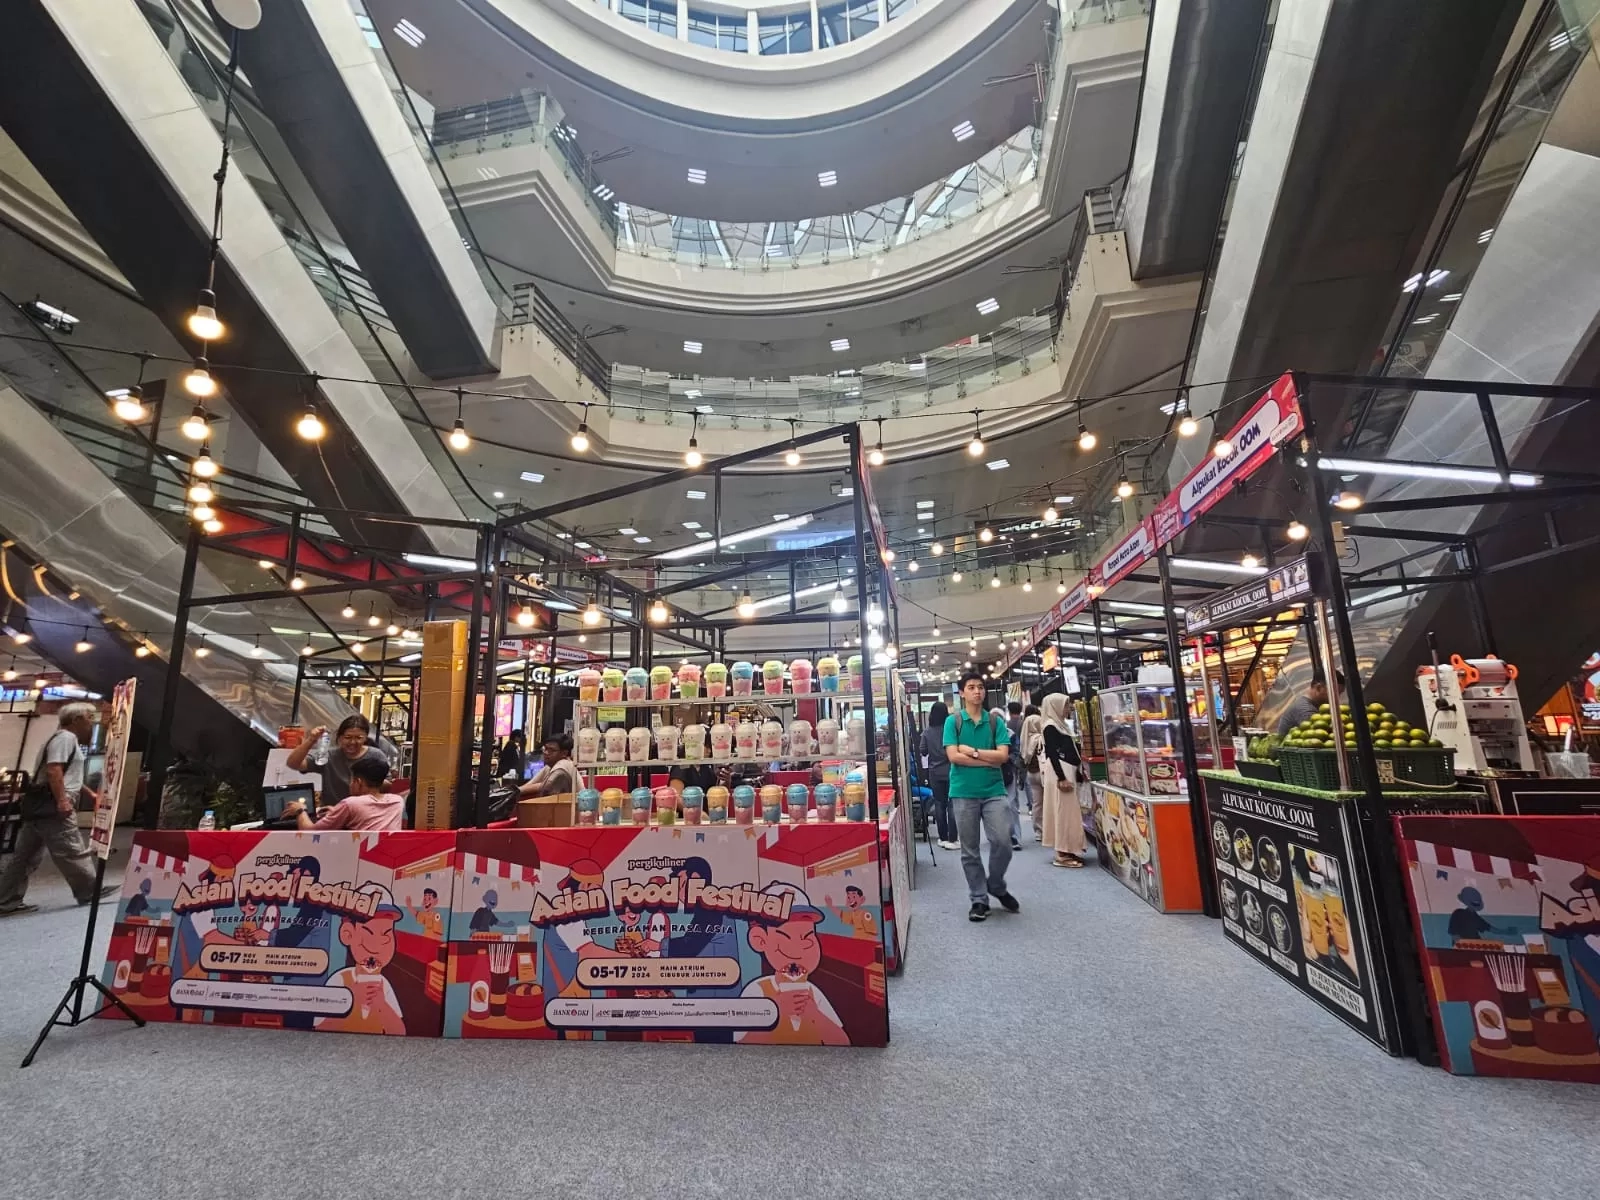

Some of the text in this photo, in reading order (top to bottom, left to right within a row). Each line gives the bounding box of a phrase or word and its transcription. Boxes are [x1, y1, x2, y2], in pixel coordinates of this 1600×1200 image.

[1191, 466, 1217, 497] Alpukat
[1239, 421, 1262, 452] OOM
[1221, 791, 1315, 828] ALPUKAT KOCOK_OOM
[628, 857, 686, 871] pergikuliner
[171, 872, 384, 921] Asian Food Festival
[529, 876, 795, 925] Asian Food Festival
[582, 923, 734, 937] KEBERAGAMAN RASA ASIA
[210, 950, 242, 964] 05-17
[589, 965, 629, 980] 05-17
